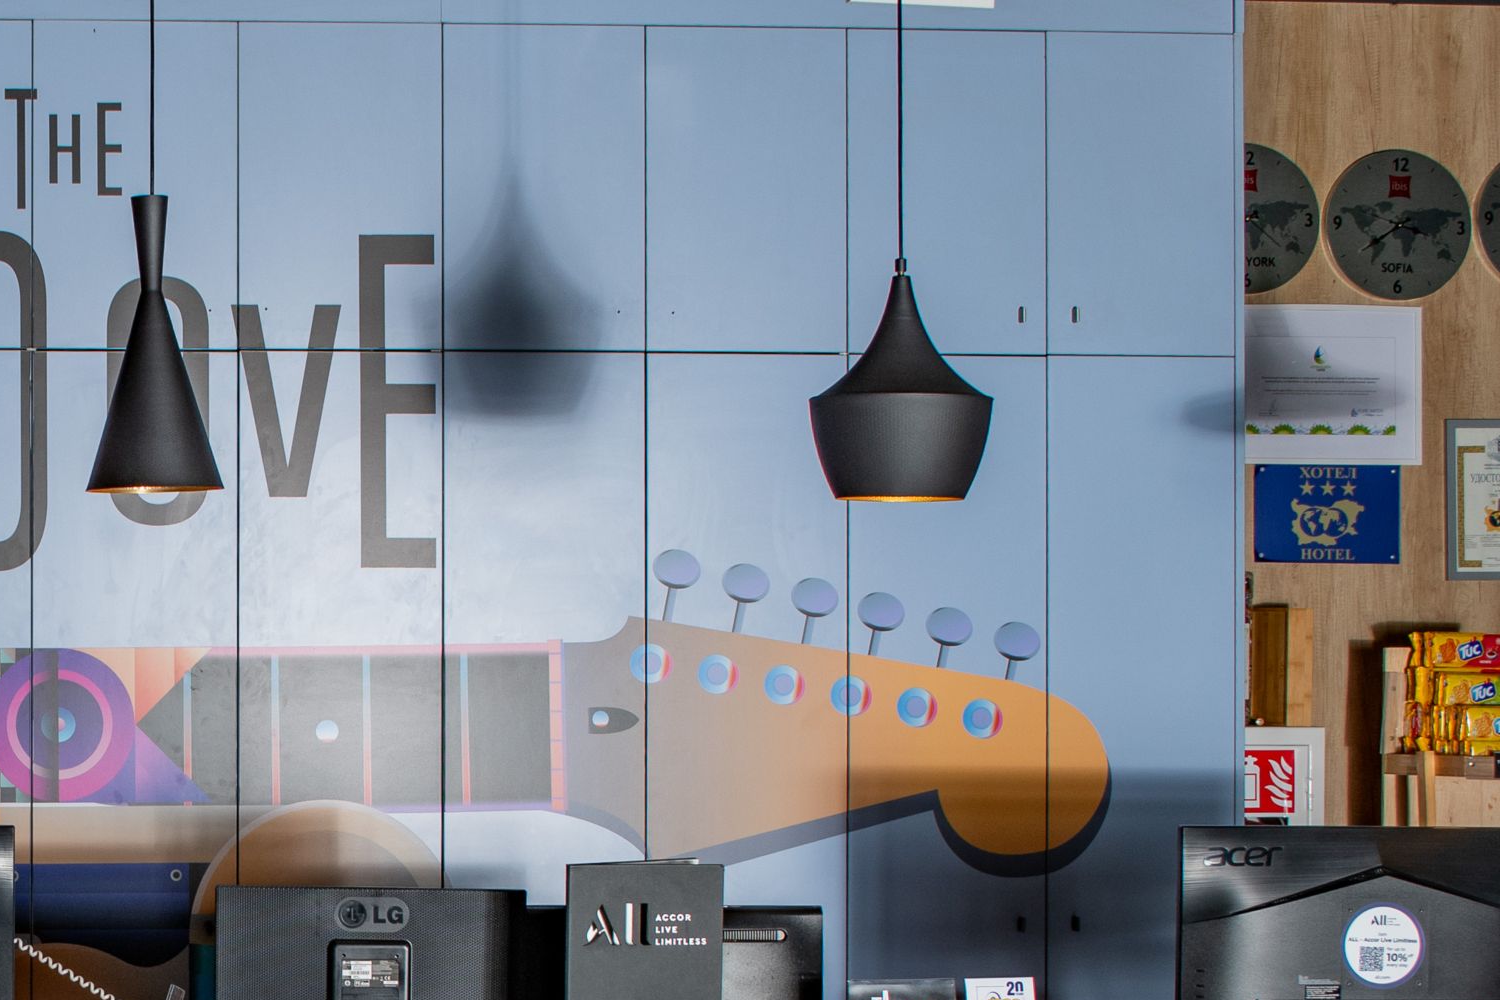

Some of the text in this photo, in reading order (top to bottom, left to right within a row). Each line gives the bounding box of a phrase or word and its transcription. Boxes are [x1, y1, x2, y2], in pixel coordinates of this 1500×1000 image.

[4, 88, 123, 210] THE
[1392, 158, 1409, 172] 12
[1392, 181, 1408, 191] ibis
[1304, 213, 1313, 227] 3
[1333, 216, 1342, 230] 9
[1484, 211, 1494, 226] 9
[1457, 221, 1466, 236] 3
[1245, 256, 1276, 267] YORK
[1381, 262, 1413, 274] SOFIA
[1393, 280, 1402, 294] 6
[1300, 466, 1357, 479] ХОТЕЛ
[1300, 548, 1356, 561] HOTEL
[1460, 644, 1481, 659] TUC
[1472, 685, 1493, 701] TUC
[1204, 846, 1283, 867] acer
[373, 905, 404, 924] LG
[655, 913, 692, 922] ACCOR
[1371, 915, 1387, 925] All
[581, 902, 651, 946] All
[655, 926, 678, 934] LIVE
[655, 937, 708, 946] LIMITLESS
[1387, 953, 1407, 962] 10%
